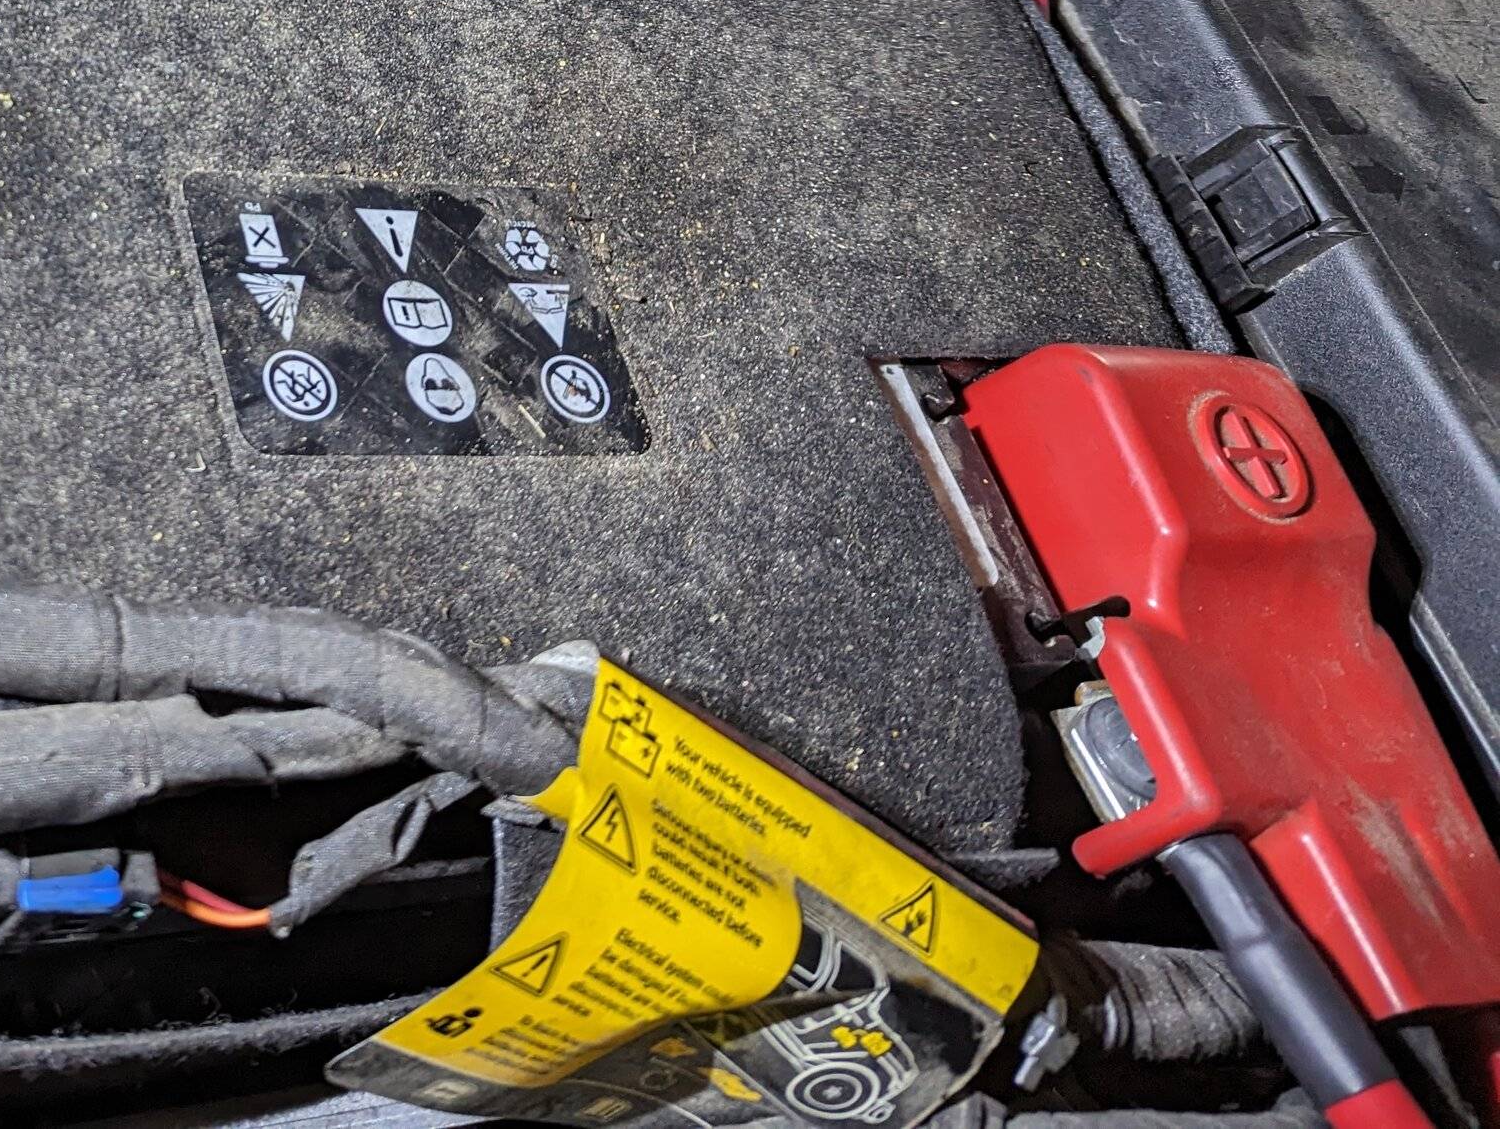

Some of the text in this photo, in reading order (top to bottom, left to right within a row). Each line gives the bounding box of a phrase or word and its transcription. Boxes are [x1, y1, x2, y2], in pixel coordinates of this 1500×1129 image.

[666, 760, 692, 786] with
[693, 777, 717, 802] two
[674, 735, 702, 765] Your
[702, 759, 743, 793] vehicle
[754, 794, 813, 839] equipped
[652, 839, 704, 884] batteries
[646, 865, 726, 924] disconnected
[725, 913, 765, 949] before
[614, 927, 672, 968] Electrical
[663, 961, 706, 989] system
